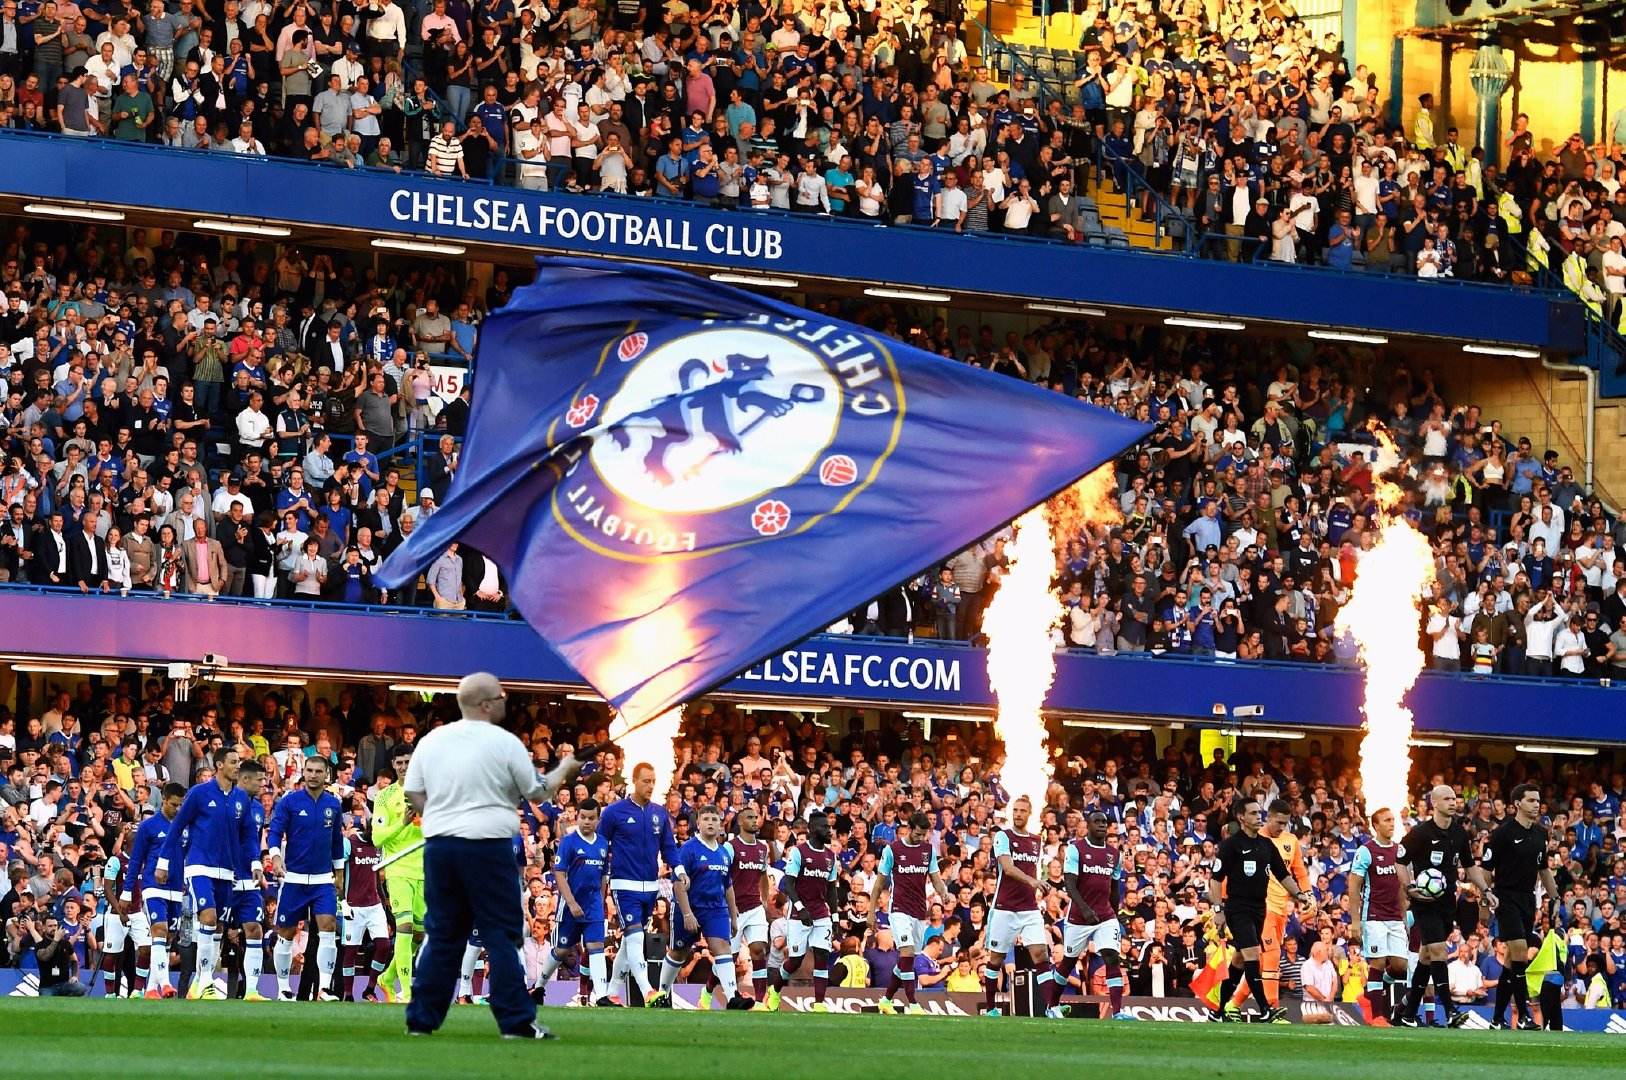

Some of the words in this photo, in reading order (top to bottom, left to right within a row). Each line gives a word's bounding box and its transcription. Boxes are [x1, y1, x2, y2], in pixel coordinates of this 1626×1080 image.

[390, 189, 531, 234] CHELSEA
[539, 205, 698, 251] FOOTBALL
[705, 223, 783, 260] CLUB
